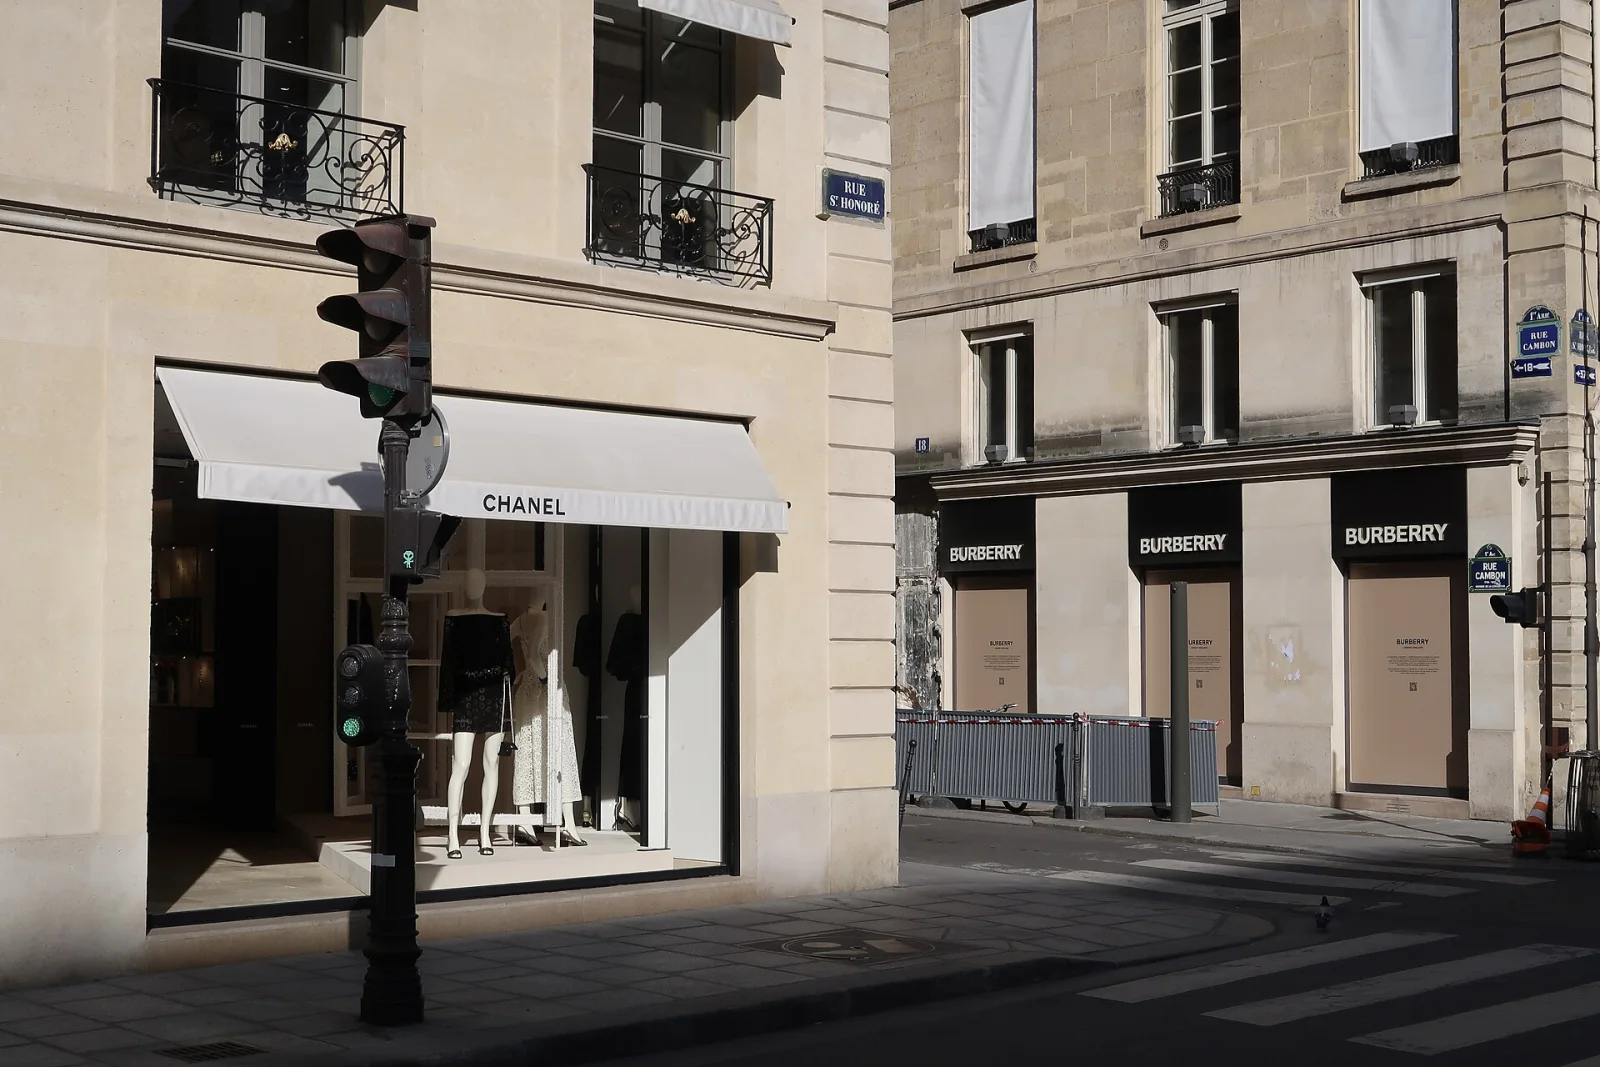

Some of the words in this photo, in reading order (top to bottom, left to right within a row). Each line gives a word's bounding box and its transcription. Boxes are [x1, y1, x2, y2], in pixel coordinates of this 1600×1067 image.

[844, 180, 866, 197] RUE
[840, 196, 880, 215] HONORÉ
[1530, 331, 1548, 340] RUE
[1523, 340, 1556, 351] CAMBON
[1523, 363, 1533, 373] 18
[918, 439, 927, 452] 18
[483, 494, 566, 516] CHANEL
[1345, 523, 1448, 545] BURBERRY
[1140, 533, 1227, 555] BURBERRY
[949, 544, 1023, 562] BURBERRY
[1482, 562, 1498, 571] RUE
[1475, 571, 1506, 580] CAMBON
